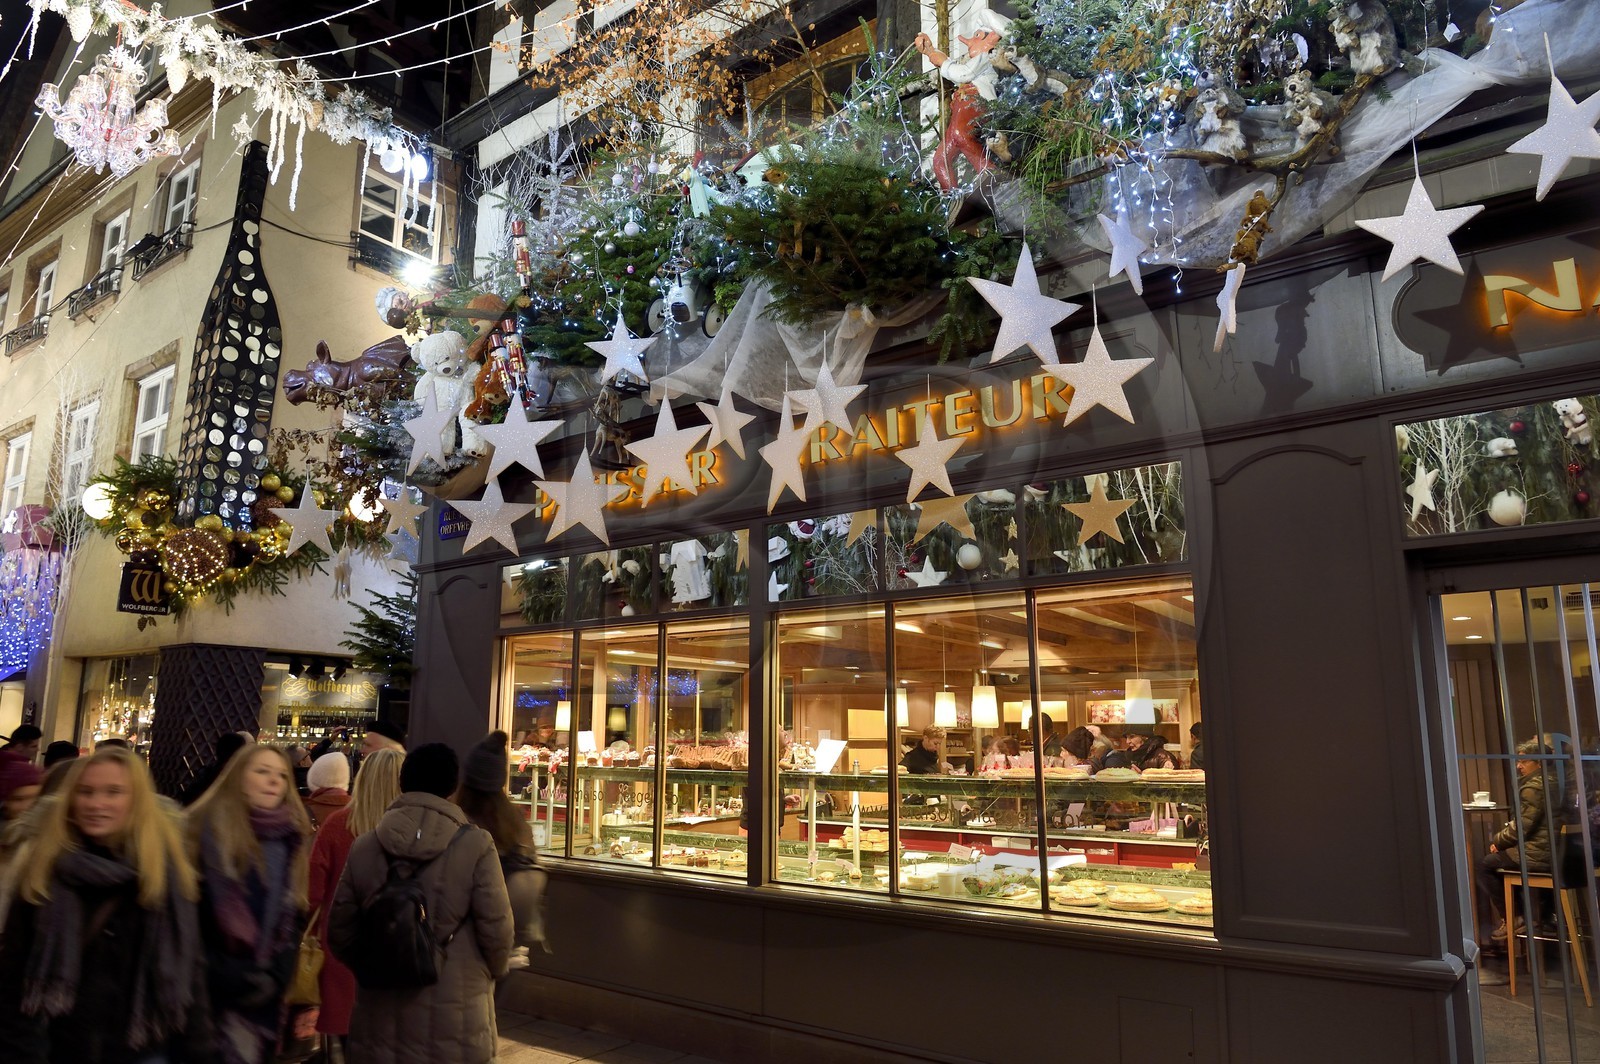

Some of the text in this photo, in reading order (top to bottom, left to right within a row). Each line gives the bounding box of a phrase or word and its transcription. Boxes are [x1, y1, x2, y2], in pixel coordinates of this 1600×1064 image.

[1484, 257, 1600, 328] N
[810, 372, 1072, 465] RAITEUR
[307, 679, 362, 695] Wolfberger
